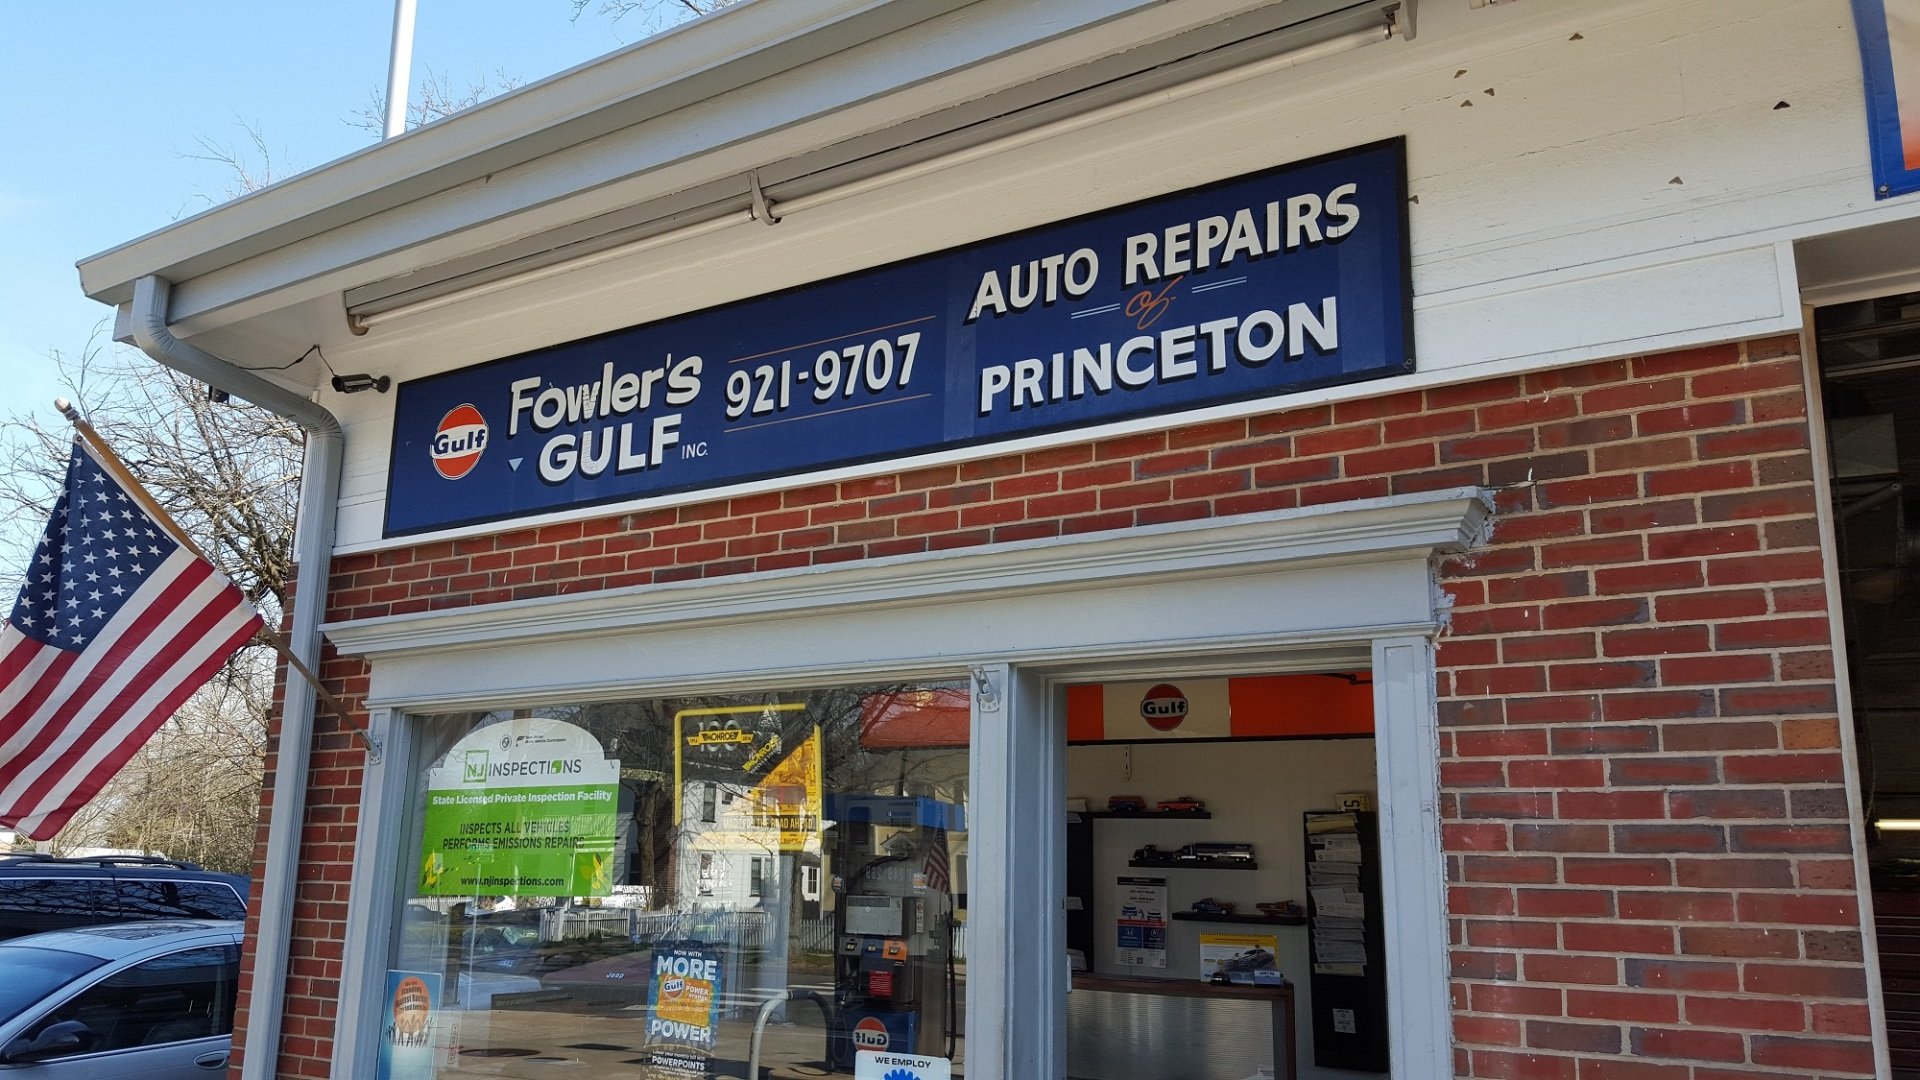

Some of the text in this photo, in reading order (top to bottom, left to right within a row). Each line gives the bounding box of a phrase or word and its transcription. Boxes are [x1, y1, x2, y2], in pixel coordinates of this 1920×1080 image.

[967, 183, 1360, 320] AUTO REPAIRS
[1125, 275, 1184, 330] of
[980, 296, 1338, 413] PRINCETON
[726, 332, 921, 418] 921-9707
[509, 352, 703, 436] Fowler's
[432, 428, 488, 456] Gulf
[538, 413, 682, 483] GULF
[681, 441, 708, 460] INC.
[1142, 700, 1187, 717] Gulf
[701, 731, 739, 742] MONROE
[432, 789, 612, 805] State Licensed Private Inspection Facility
[460, 820, 570, 835] INSPECTS ALL VEHICLES
[443, 836, 585, 850] PERFORMS EMISSIONS REPAIRS
[460, 875, 564, 888] www.njinspections.com
[673, 949, 703, 958] NOW WITH
[656, 955, 718, 981] MORE
[664, 980, 684, 991] Gulf
[685, 985, 709, 995] POWER
[651, 1019, 711, 1043] POWER
[651, 1055, 705, 1071] POWERPOINTS
[874, 1055, 932, 1069] WE EMPLOY
